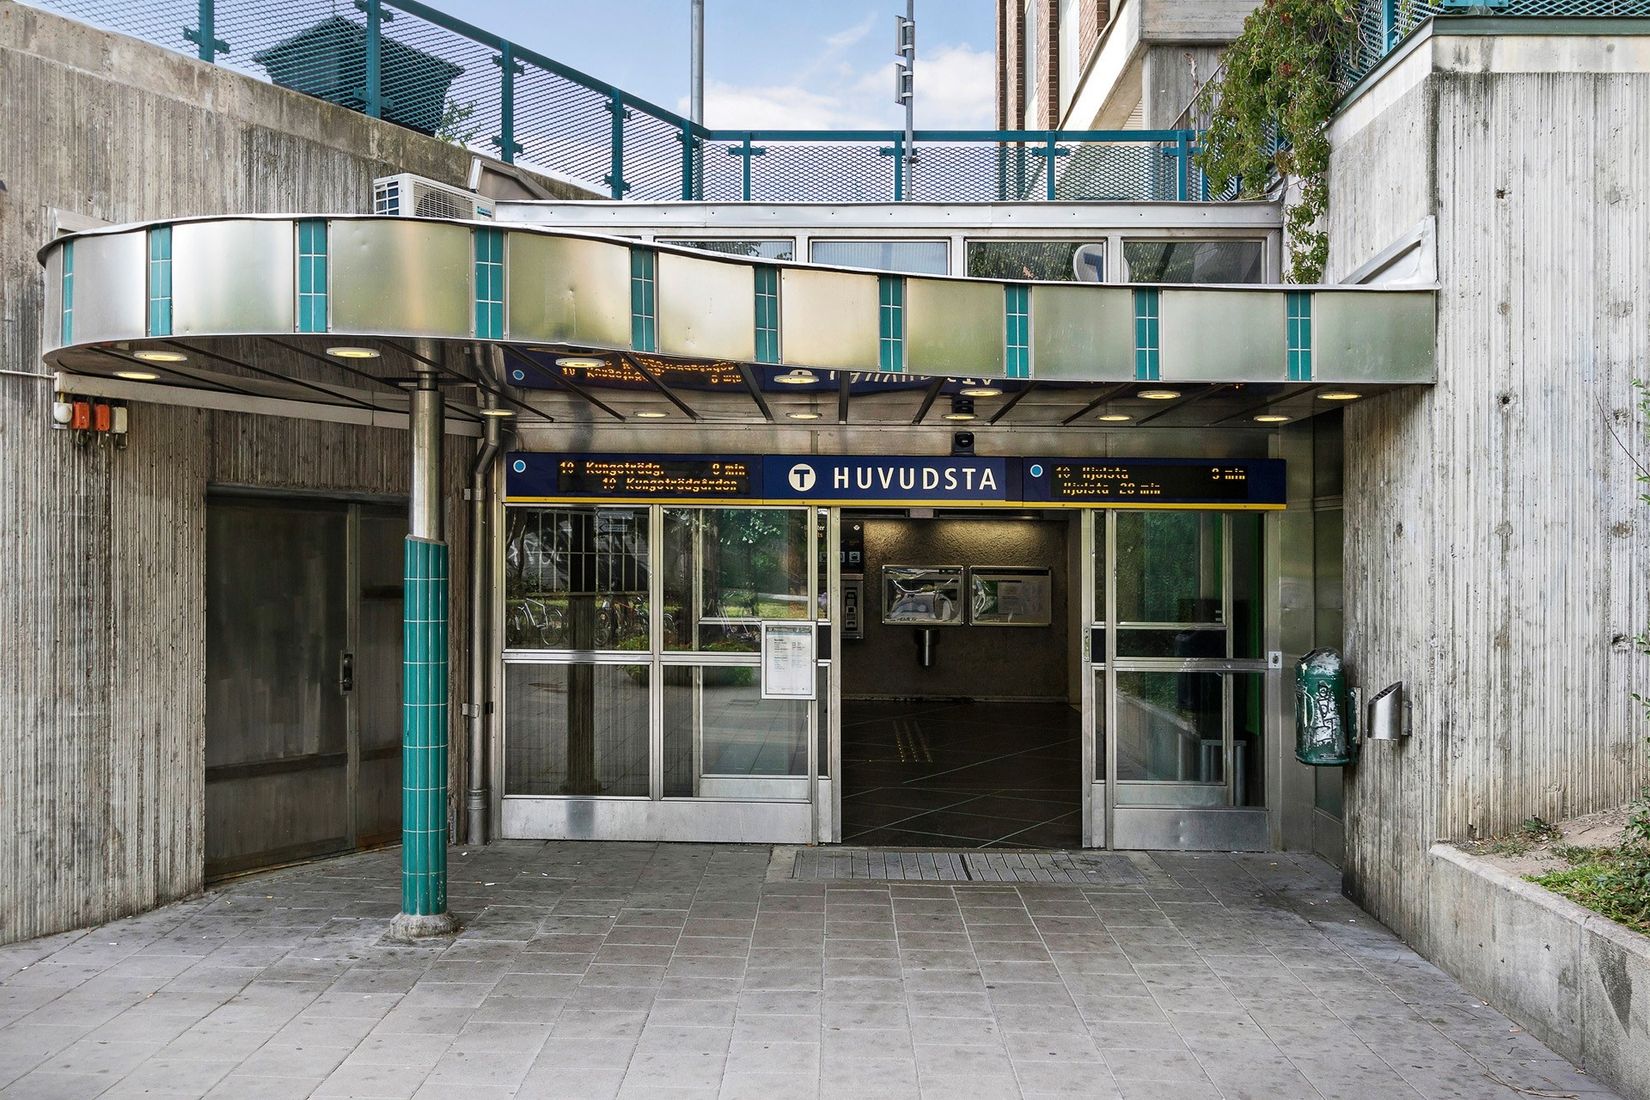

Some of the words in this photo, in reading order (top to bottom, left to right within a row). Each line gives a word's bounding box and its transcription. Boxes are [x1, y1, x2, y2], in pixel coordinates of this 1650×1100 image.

[725, 463, 745, 475] min
[1225, 467, 1246, 480] min
[833, 466, 997, 491] HUVUDSTA
[1140, 483, 1161, 495] min
